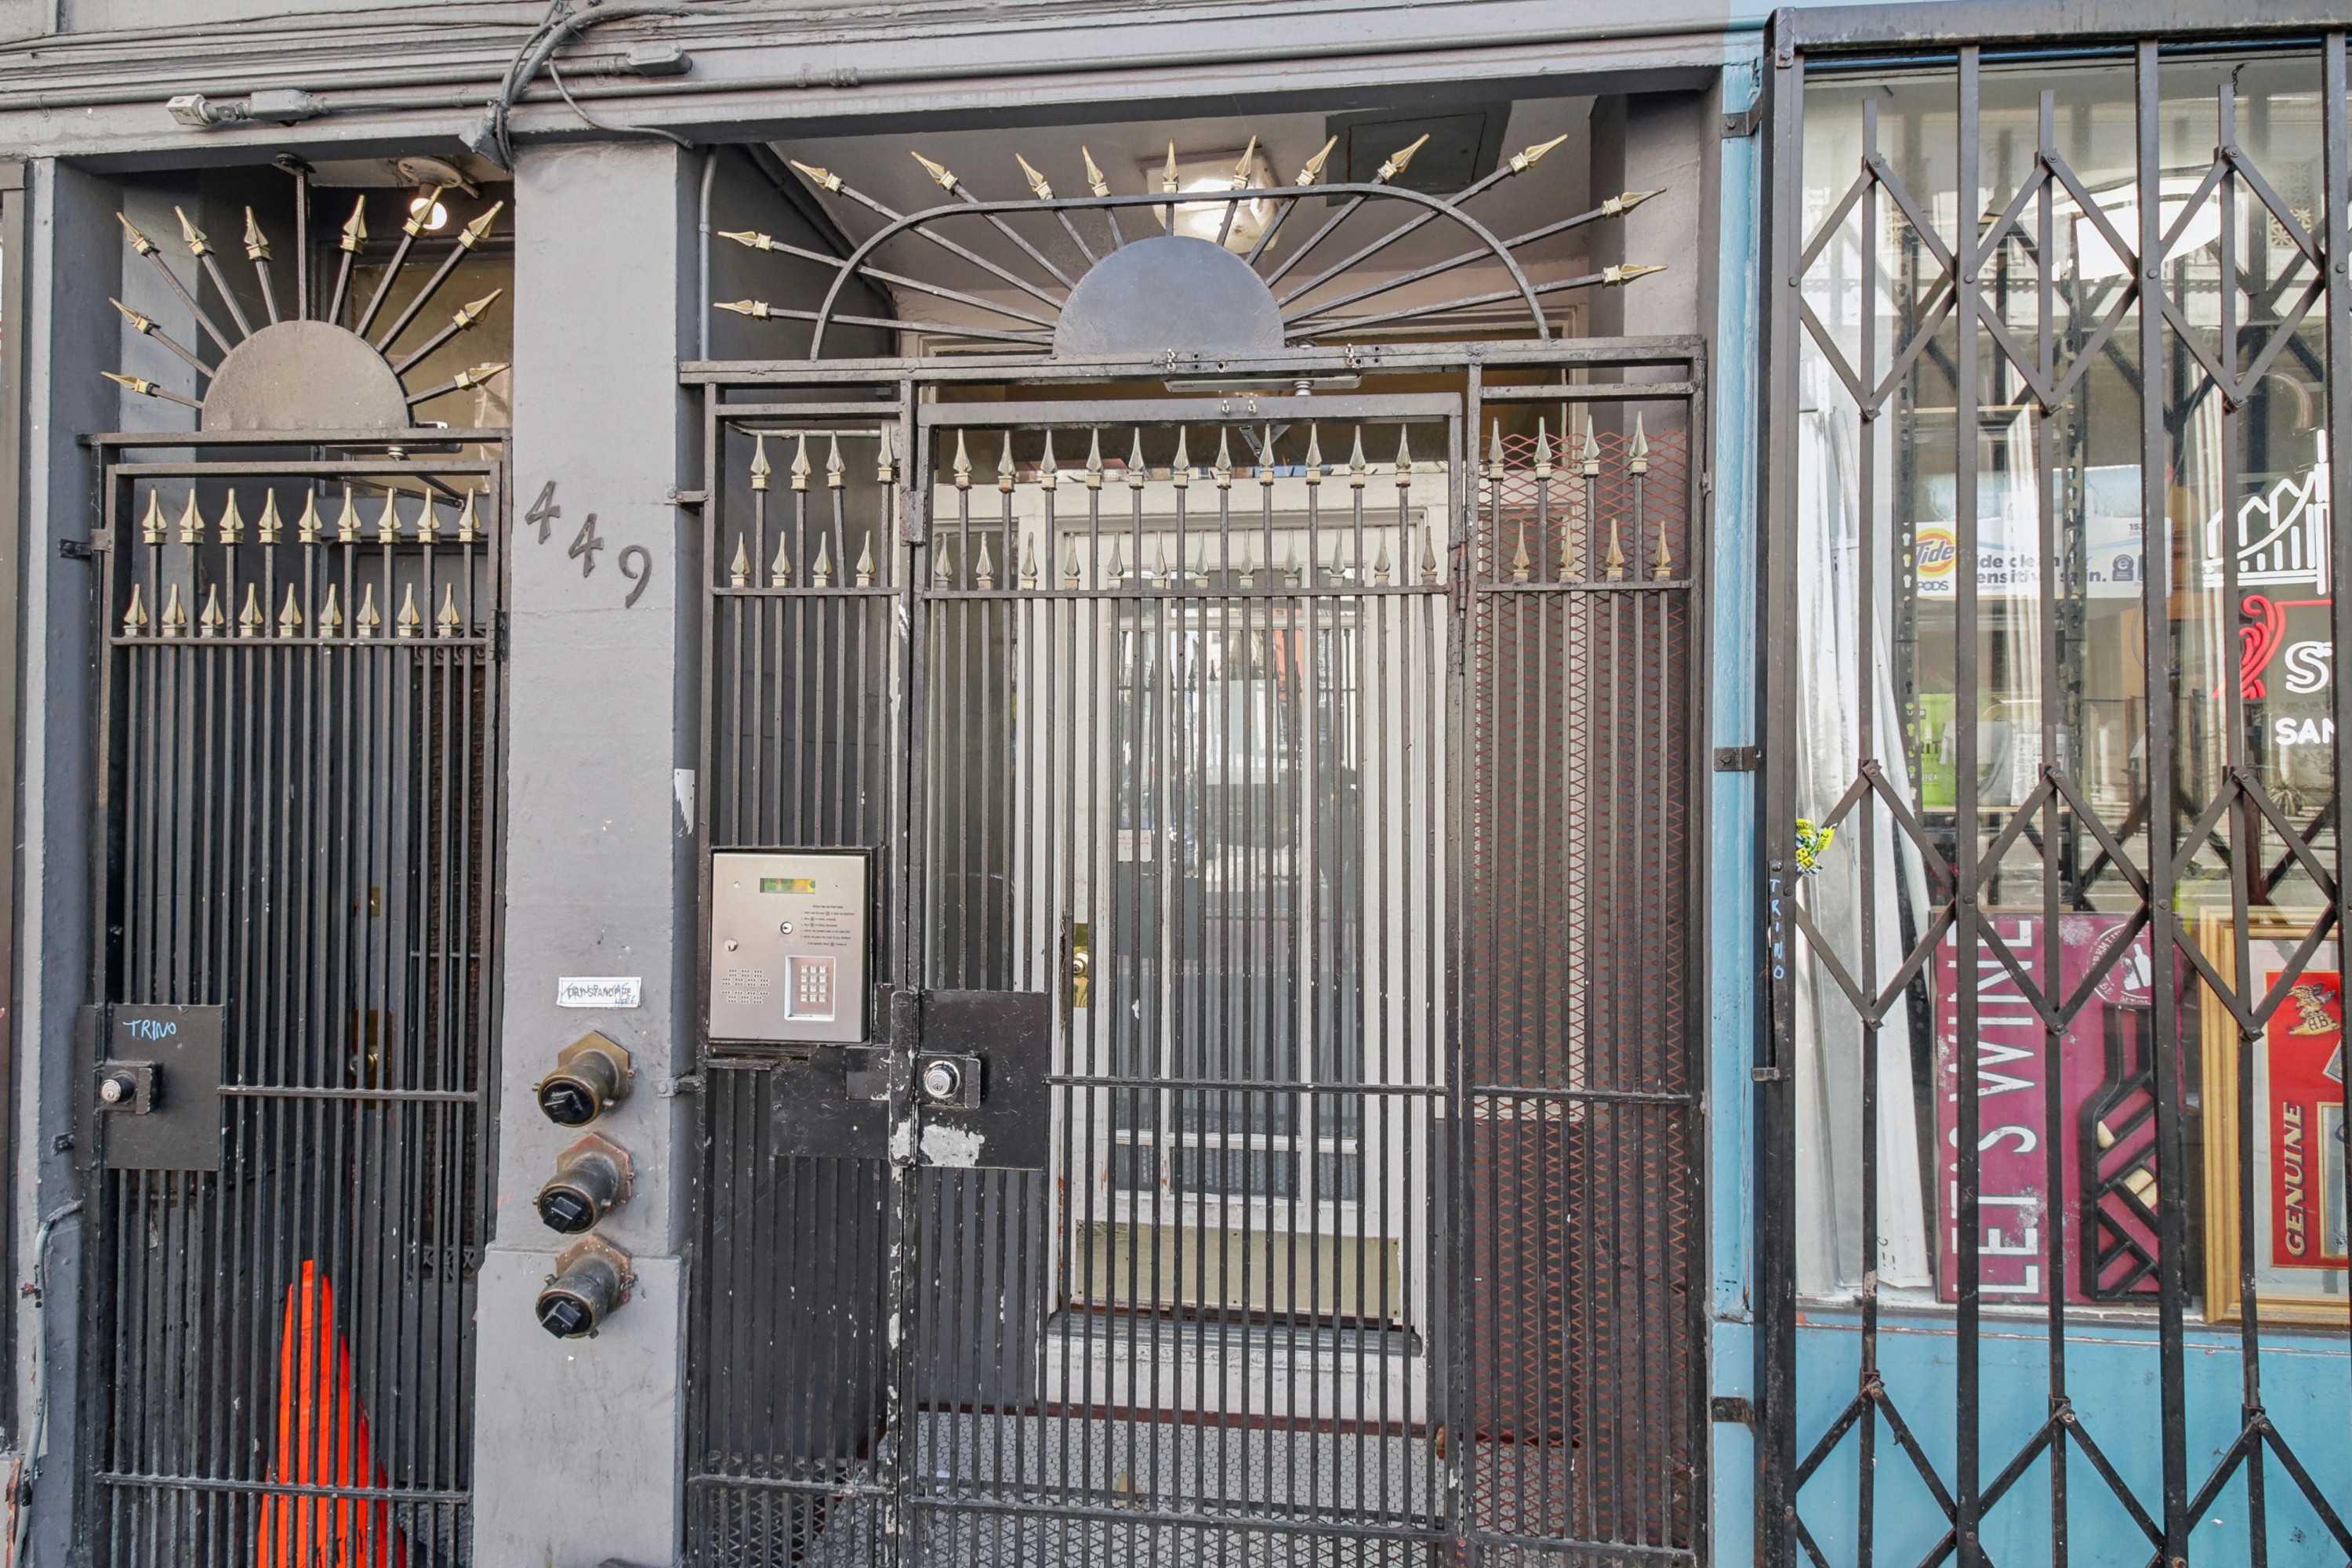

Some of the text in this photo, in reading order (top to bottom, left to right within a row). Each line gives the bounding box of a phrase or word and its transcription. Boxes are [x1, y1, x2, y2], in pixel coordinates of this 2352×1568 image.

[524, 481, 652, 608] 449
[1915, 539, 1955, 567] Tide
[1917, 580, 1949, 591] PODS
[1769, 879, 1785, 980] TRINO
[122, 1019, 177, 1041] TRINO
[2307, 1014, 2329, 1033] AB
[1946, 920, 2039, 1294] LET'S WINE
[2283, 1102, 2306, 1258] GENUINE
